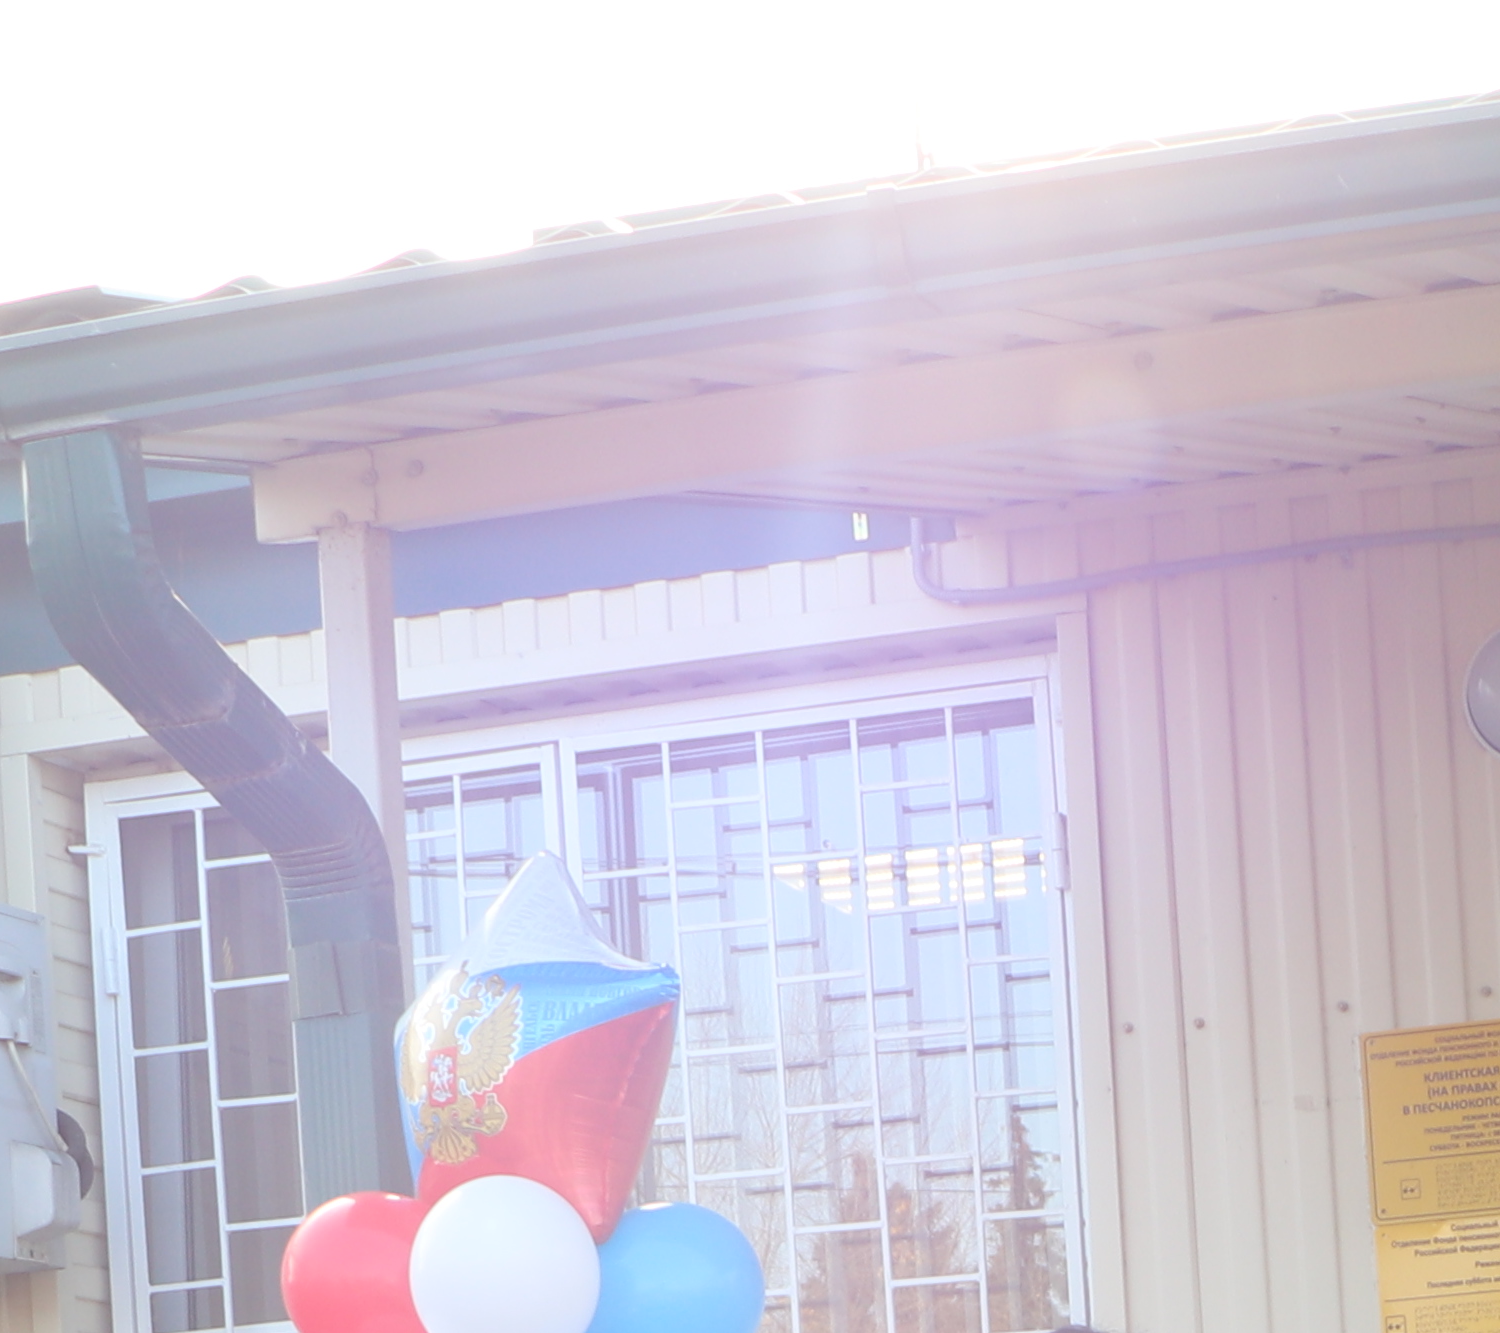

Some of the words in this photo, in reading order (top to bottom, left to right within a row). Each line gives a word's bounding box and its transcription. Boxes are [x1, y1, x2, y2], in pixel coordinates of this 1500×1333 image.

[1423, 1066, 1500, 1083] КЛИЕНТСКАЯ
[1427, 1087, 1448, 1099] (НА
[1451, 1083, 1497, 1096] ПРАВАХ
[1403, 1106, 1411, 1115] В
